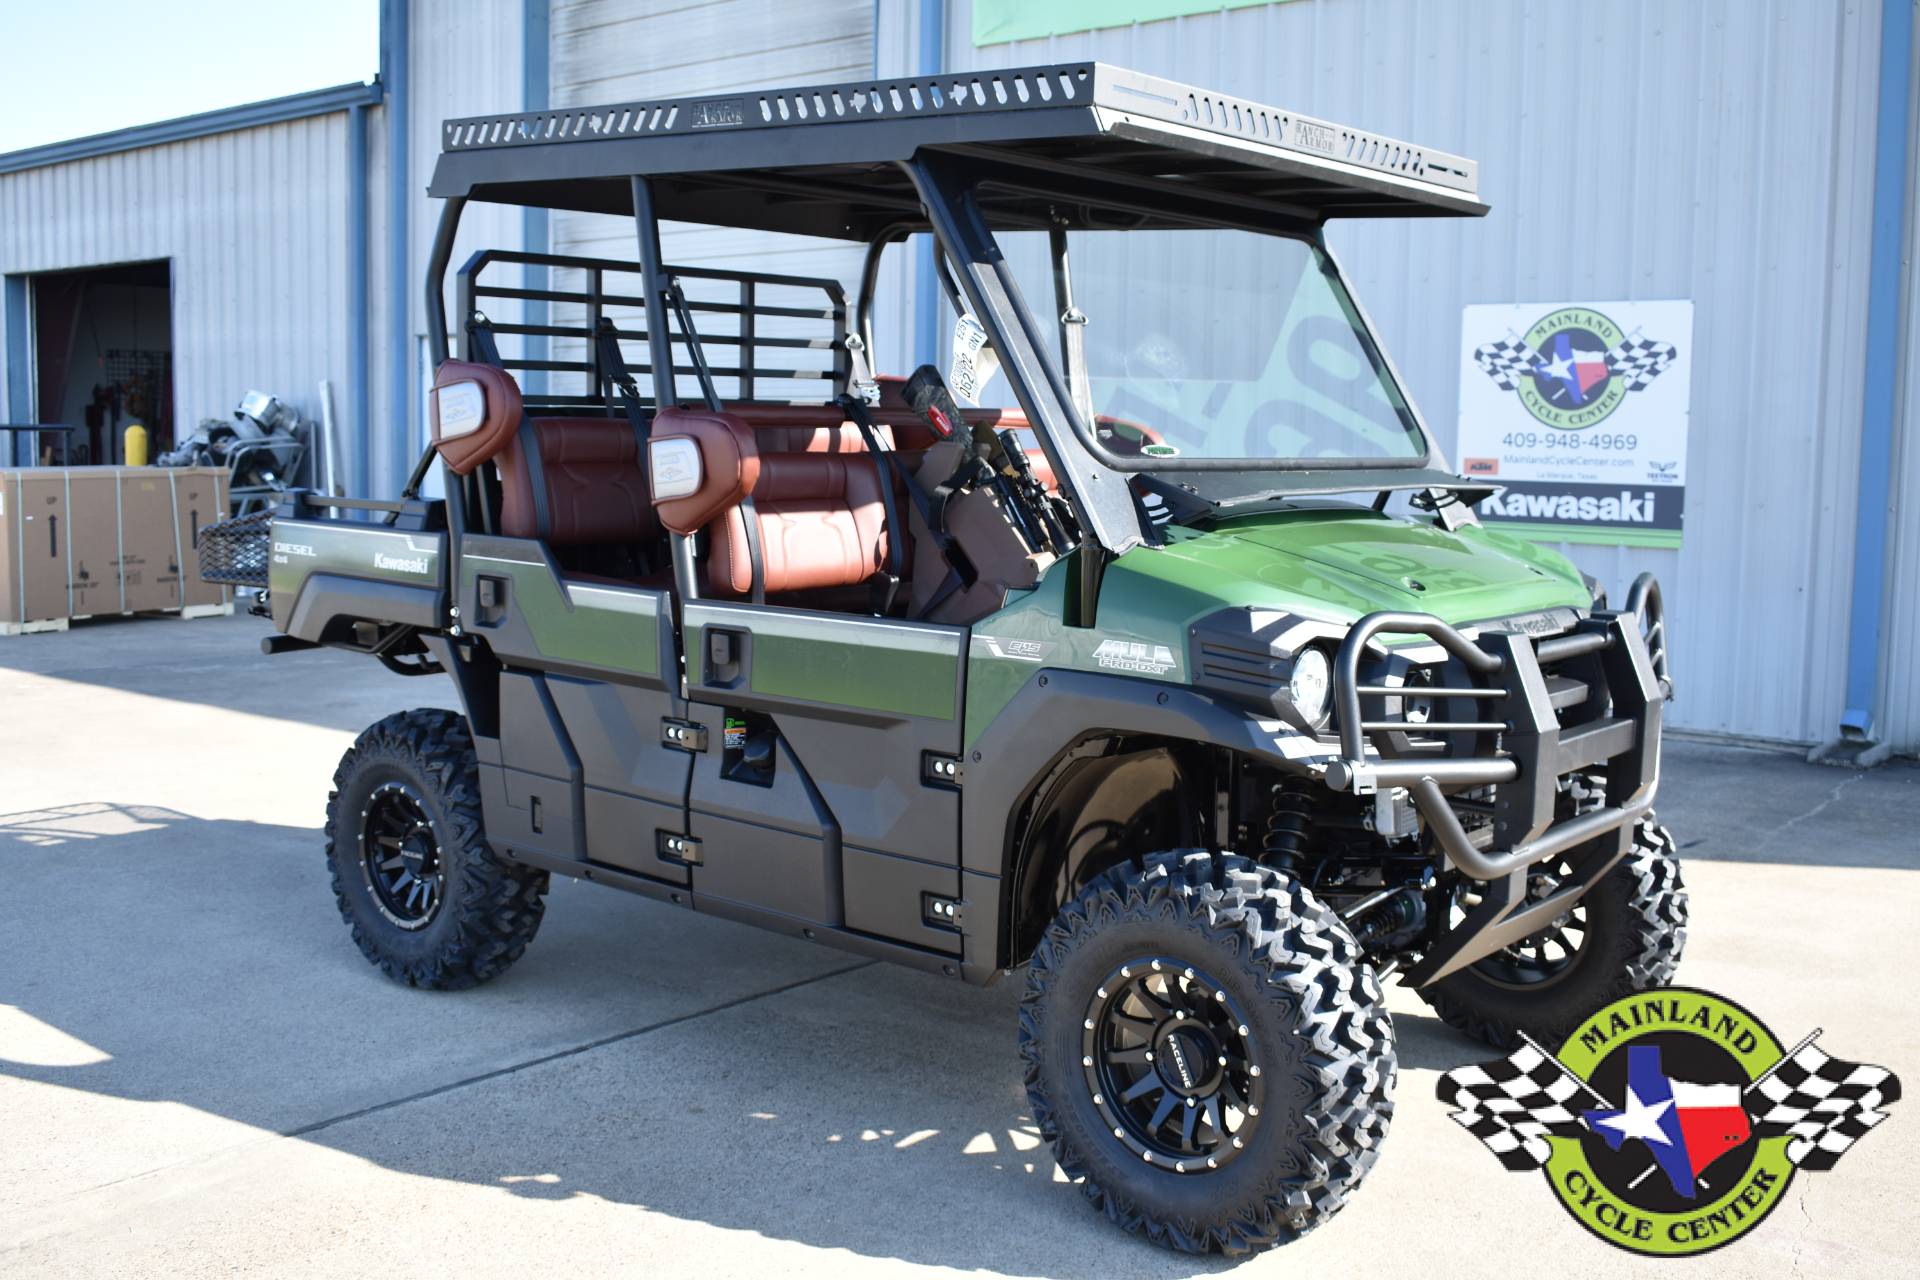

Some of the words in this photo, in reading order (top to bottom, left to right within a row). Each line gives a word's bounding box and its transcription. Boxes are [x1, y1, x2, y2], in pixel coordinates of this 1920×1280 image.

[1535, 313, 1614, 339] MAINLAND
[1525, 390, 1562, 424] CYCLE
[1568, 389, 1619, 425] CENTER
[1502, 432, 1638, 450] 409-948-4969
[1481, 486, 1656, 523] Kawasaki
[274, 542, 317, 557] DIESEL
[373, 552, 429, 574] Kawasaki
[1167, 1034, 1192, 1089] RACELINE
